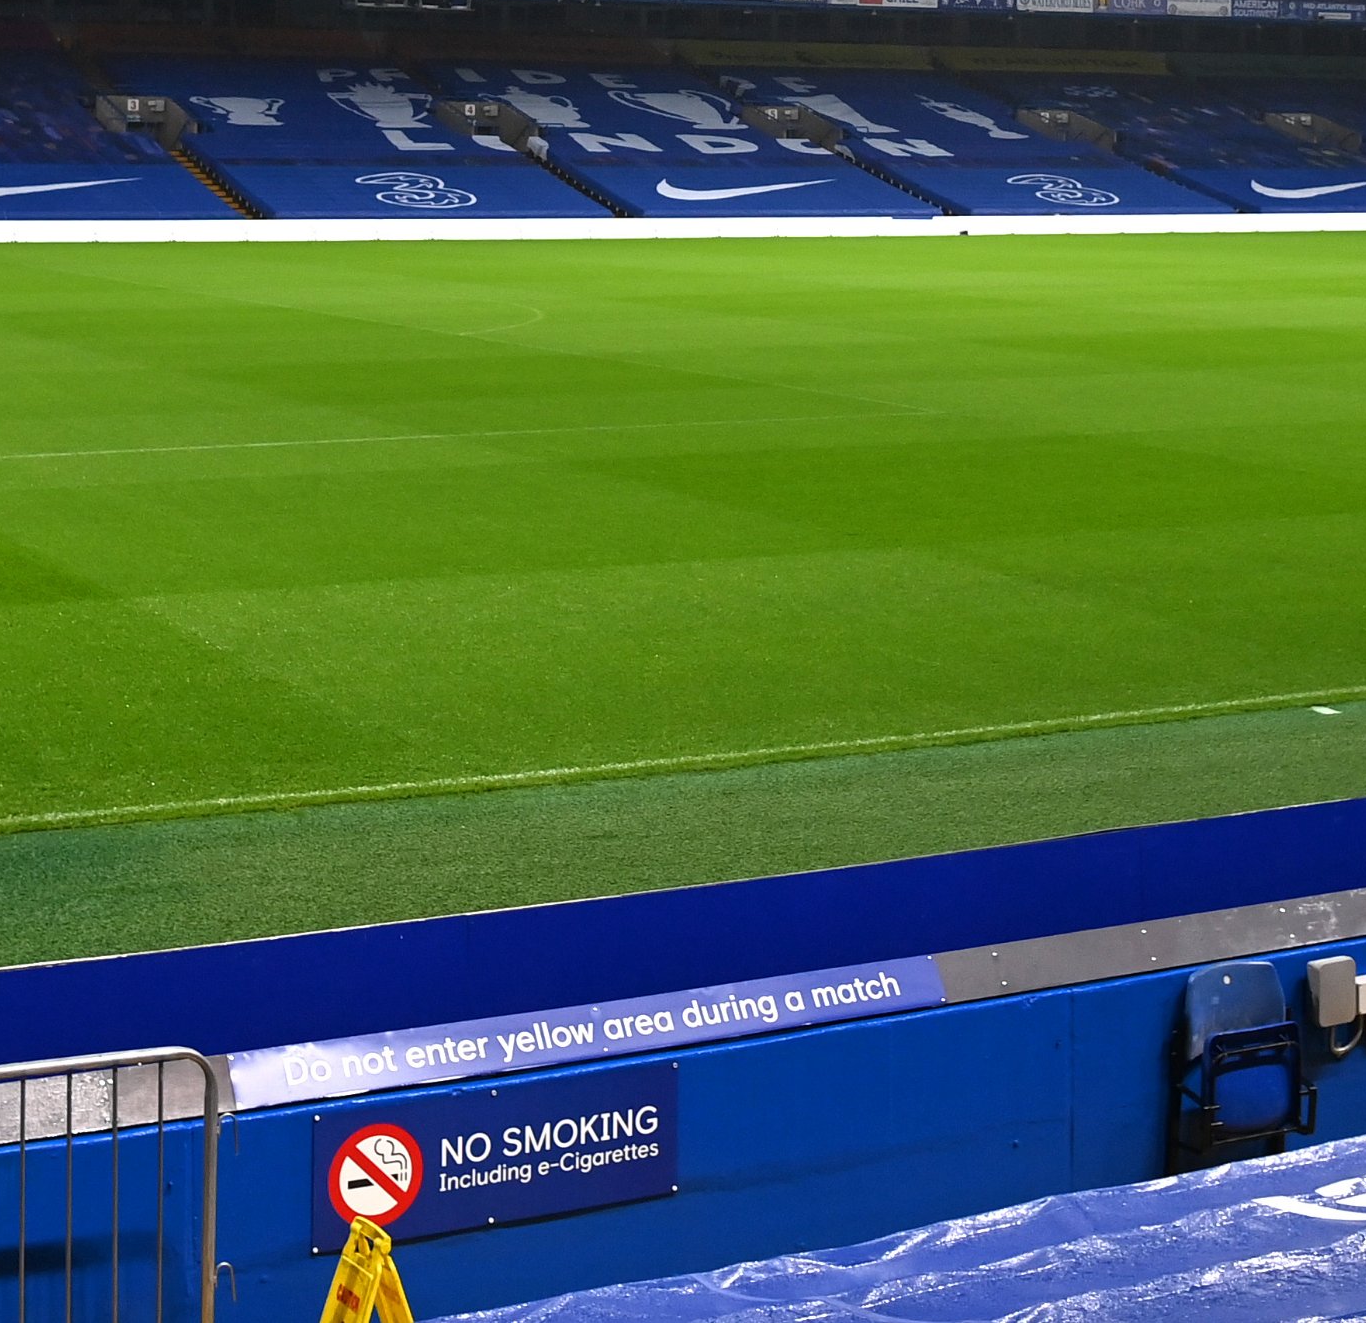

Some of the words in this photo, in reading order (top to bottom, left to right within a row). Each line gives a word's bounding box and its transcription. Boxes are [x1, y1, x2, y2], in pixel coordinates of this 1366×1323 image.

[1233, 0, 1279, 10] AMERICAN
[1234, 8, 1278, 18] SOUTHWEST
[283, 1055, 332, 1087] Do
[341, 1045, 398, 1078] not
[405, 1033, 489, 1070] enter
[498, 1019, 595, 1065] yellow
[602, 1009, 675, 1041] area
[681, 991, 779, 1033] during
[784, 991, 806, 1014] a
[810, 972, 902, 1008] match
[439, 1131, 492, 1168] NO
[502, 1105, 659, 1160] SMOKING
[438, 1161, 533, 1193] Including
[537, 1140, 660, 1177] e-Cigarettes
